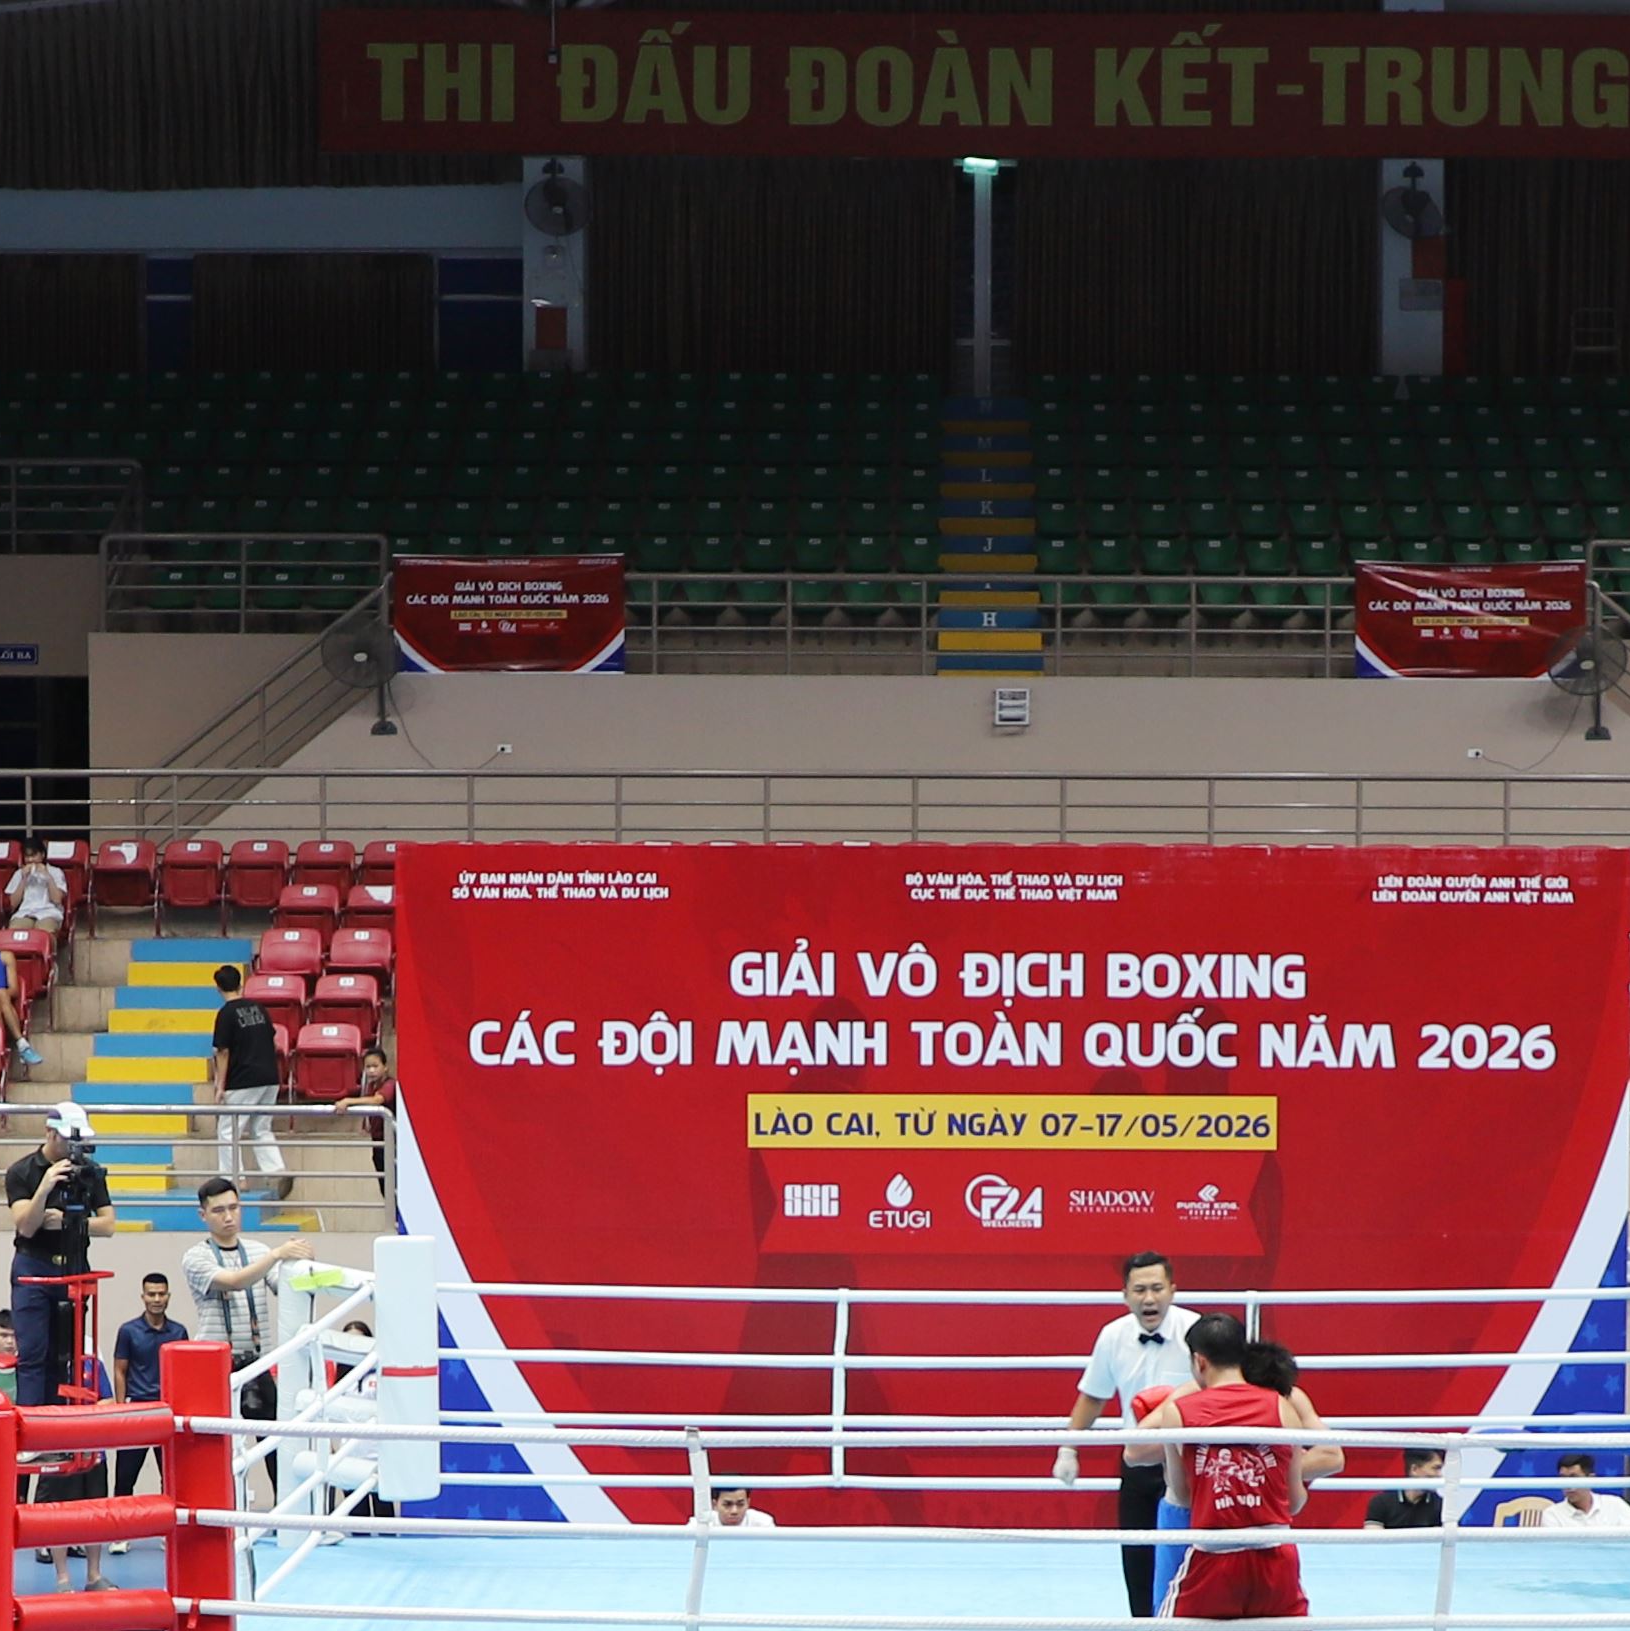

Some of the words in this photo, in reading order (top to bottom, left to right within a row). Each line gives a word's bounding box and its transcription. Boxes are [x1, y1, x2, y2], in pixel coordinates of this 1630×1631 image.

[366, 42, 515, 122] THI
[556, 20, 752, 126] ĐẤU
[785, 28, 1054, 127] ĐOÀN
[479, 872, 507, 885] BAN
[509, 870, 544, 885] NHÂN
[607, 870, 636, 885] LÀO
[636, 872, 657, 885] CAI
[1016, 872, 1051, 886] THAO
[1052, 872, 1073, 886] VÀ
[1075, 873, 1095, 886] DU
[1096, 874, 1123, 888] LỊCH
[1377, 874, 1404, 888] LIÊN
[1406, 874, 1443, 888] ĐOÀN
[1489, 876, 1516, 889] ANH
[561, 886, 597, 899] THAO
[599, 885, 619, 899] VÀ
[621, 886, 641, 899] DU
[642, 886, 669, 901] LỊCH
[910, 887, 935, 902] CỤC
[1019, 888, 1054, 900] THAO
[1056, 886, 1083, 902] VIỆT
[1086, 888, 1118, 900] NAM
[1372, 889, 1398, 902] LIÊN
[1400, 888, 1437, 903] ĐOÀN
[1483, 890, 1510, 903] ANH
[1512, 889, 1540, 905] VIỆT
[1542, 891, 1574, 904] NAM
[730, 937, 835, 998] GIẢI
[856, 942, 937, 998] VÔ
[958, 952, 1084, 1007] ĐỊCH
[1106, 952, 1307, 999] BOXING
[469, 1009, 575, 1067] CÁC
[597, 1009, 693, 1076] ĐỘI
[715, 1020, 887, 1076] MẠNH
[910, 1008, 1062, 1068] TOÀN
[1083, 1007, 1239, 1070] QUỐC
[1260, 1013, 1396, 1069] NĂM
[1418, 1023, 1557, 1071] 2026
[754, 1106, 813, 1136] LÀO
[826, 1112, 881, 1139] CAI,
[894, 1107, 938, 1137] TỪ
[947, 1107, 1028, 1137] NGÀY
[1040, 1113, 1271, 1138] 07-17/05/2026
[784, 1183, 840, 1217] SSC
[1068, 1189, 1156, 1207] SHADOW
[868, 1209, 932, 1230] ETUGI
